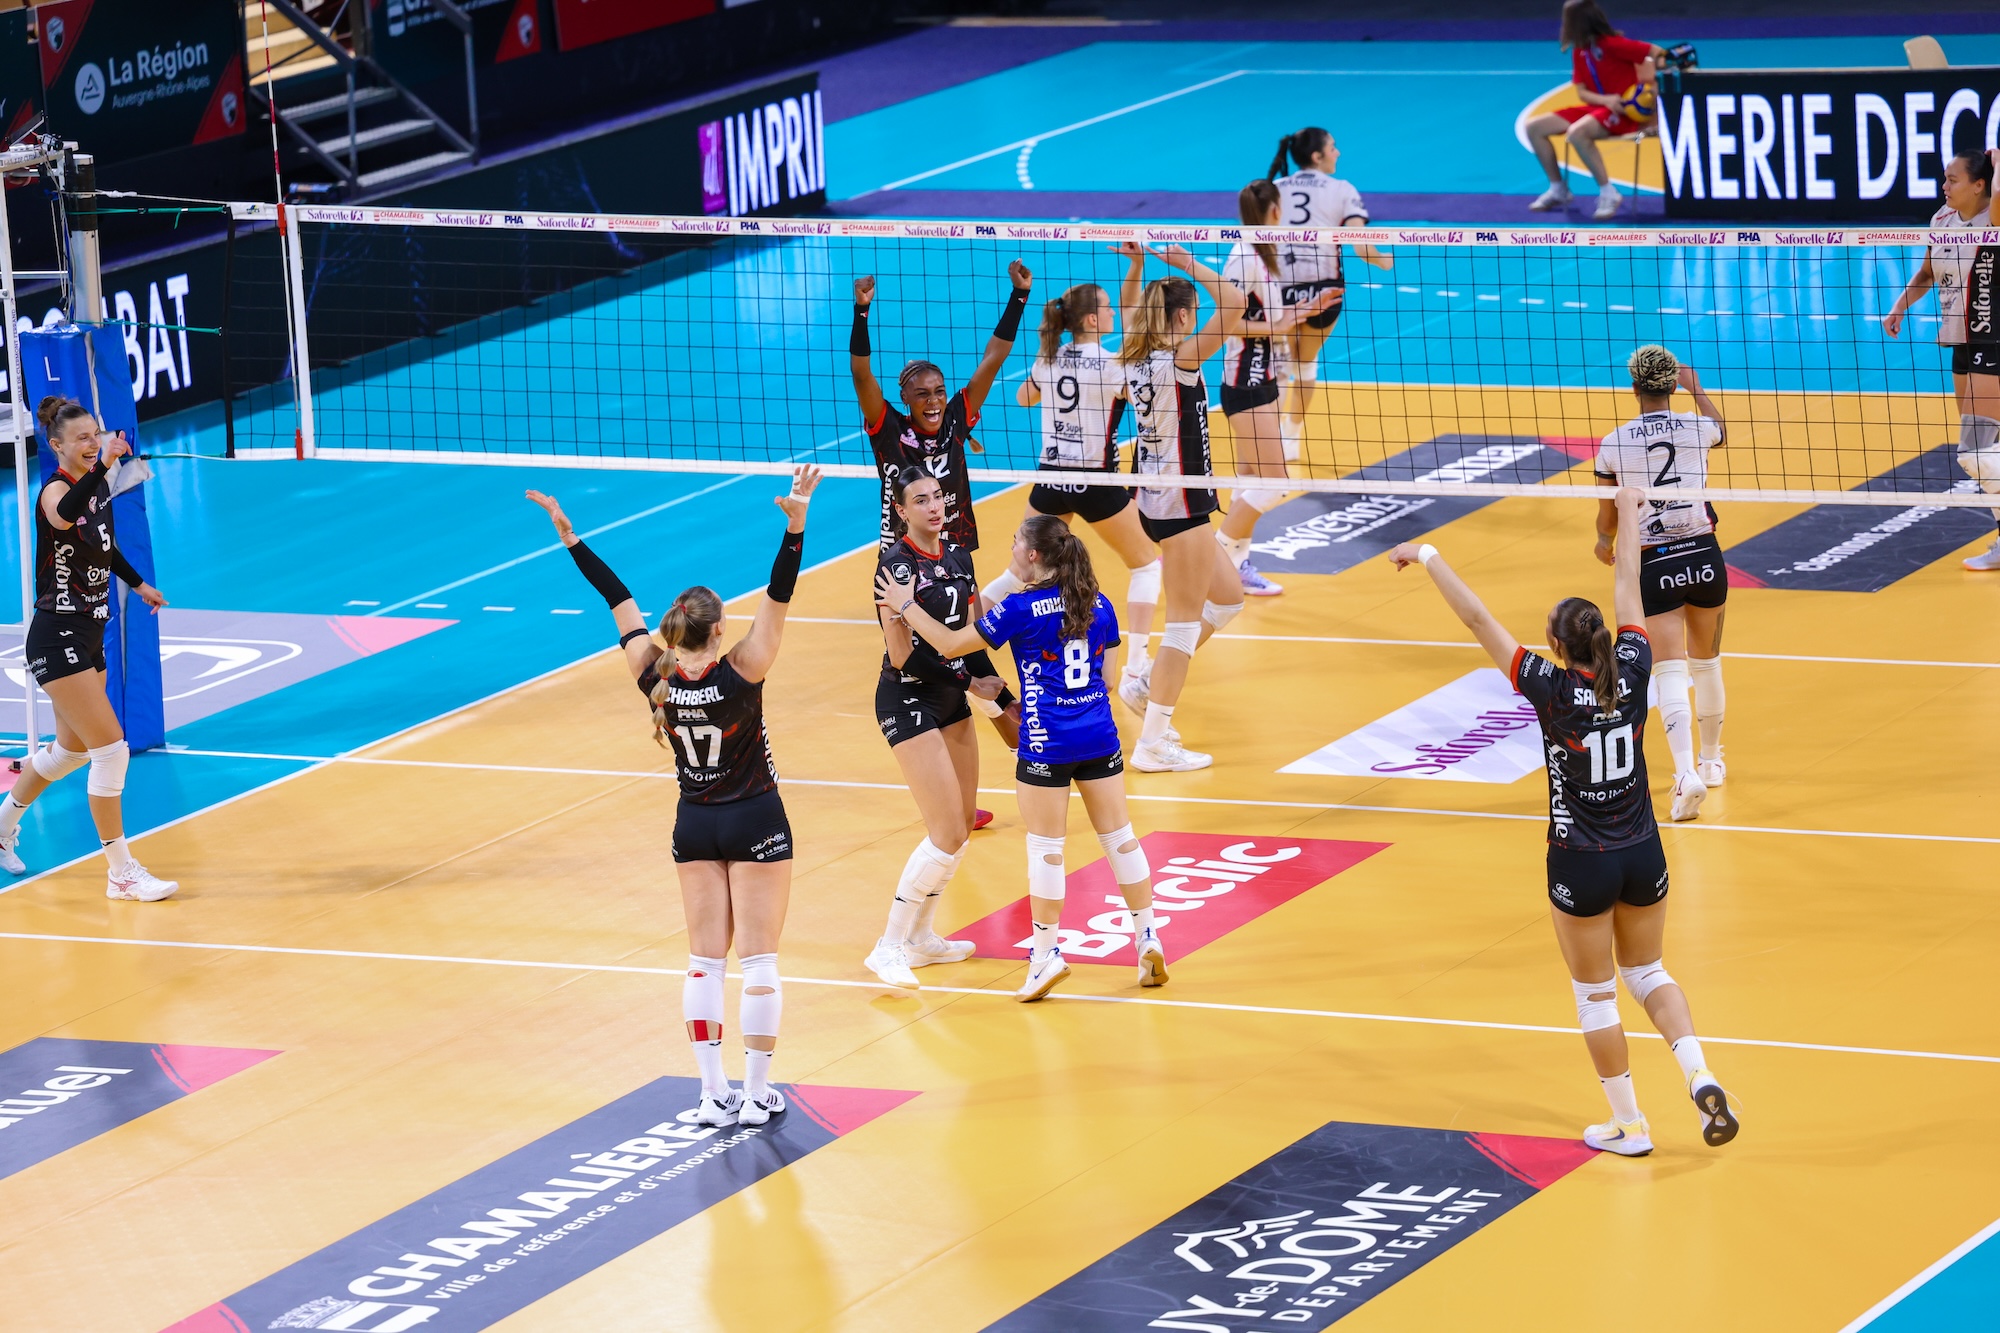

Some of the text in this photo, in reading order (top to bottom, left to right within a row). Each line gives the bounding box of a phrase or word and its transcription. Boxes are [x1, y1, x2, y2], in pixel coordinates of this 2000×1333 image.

[108, 40, 209, 87] La Région
[112, 75, 211, 109] Auvergne-Rhône-Alpes
[724, 89, 825, 217] IMPRI
[1657, 94, 1836, 200] MERIE
[1289, 191, 1311, 225] 3
[308, 209, 349, 221] Saforelle
[435, 212, 478, 225] Saforelle
[504, 215, 524, 224] PHA
[537, 216, 580, 228] Saforelle
[672, 220, 715, 232] Saforelle
[741, 222, 760, 231] PHA
[772, 222, 815, 234] Saforelle
[905, 225, 948, 237] Saforelle
[976, 226, 996, 235] PHA
[1007, 226, 1051, 238] Saforelle
[1147, 228, 1192, 240] Saforelle
[1221, 230, 1241, 239] PHA
[1255, 230, 1300, 242] Saforelle
[1399, 231, 1446, 243] Saforelle
[1476, 232, 1498, 242] PHA
[1511, 232, 1558, 244] Saforelle
[1658, 232, 1707, 244] Saforelle
[1738, 232, 1761, 242] PHA
[1775, 232, 1825, 244] Saforelle
[1928, 232, 1980, 244] Saforelle
[1970, 251, 1995, 333] Saforelle
[1973, 353, 1983, 365] 5
[44, 356, 60, 380] L
[1057, 375, 1080, 413] 9
[1629, 419, 1685, 440] TAURAA
[923, 453, 950, 479] 12
[1647, 441, 1681, 488] 2
[98, 523, 110, 552] 5
[64, 647, 79, 664] 5
[1063, 639, 1091, 689] 8
[1021, 659, 1049, 754] Saforelle
[677, 709, 708, 719] PHA
[910, 711, 921, 726] 7
[674, 725, 723, 767] 17
[1581, 723, 1634, 784] 10
[1580, 791, 1606, 802] PRO
[1013, 841, 1302, 958] Betclic
[425, 1126, 763, 1300] Ville de référence et d'innovation
